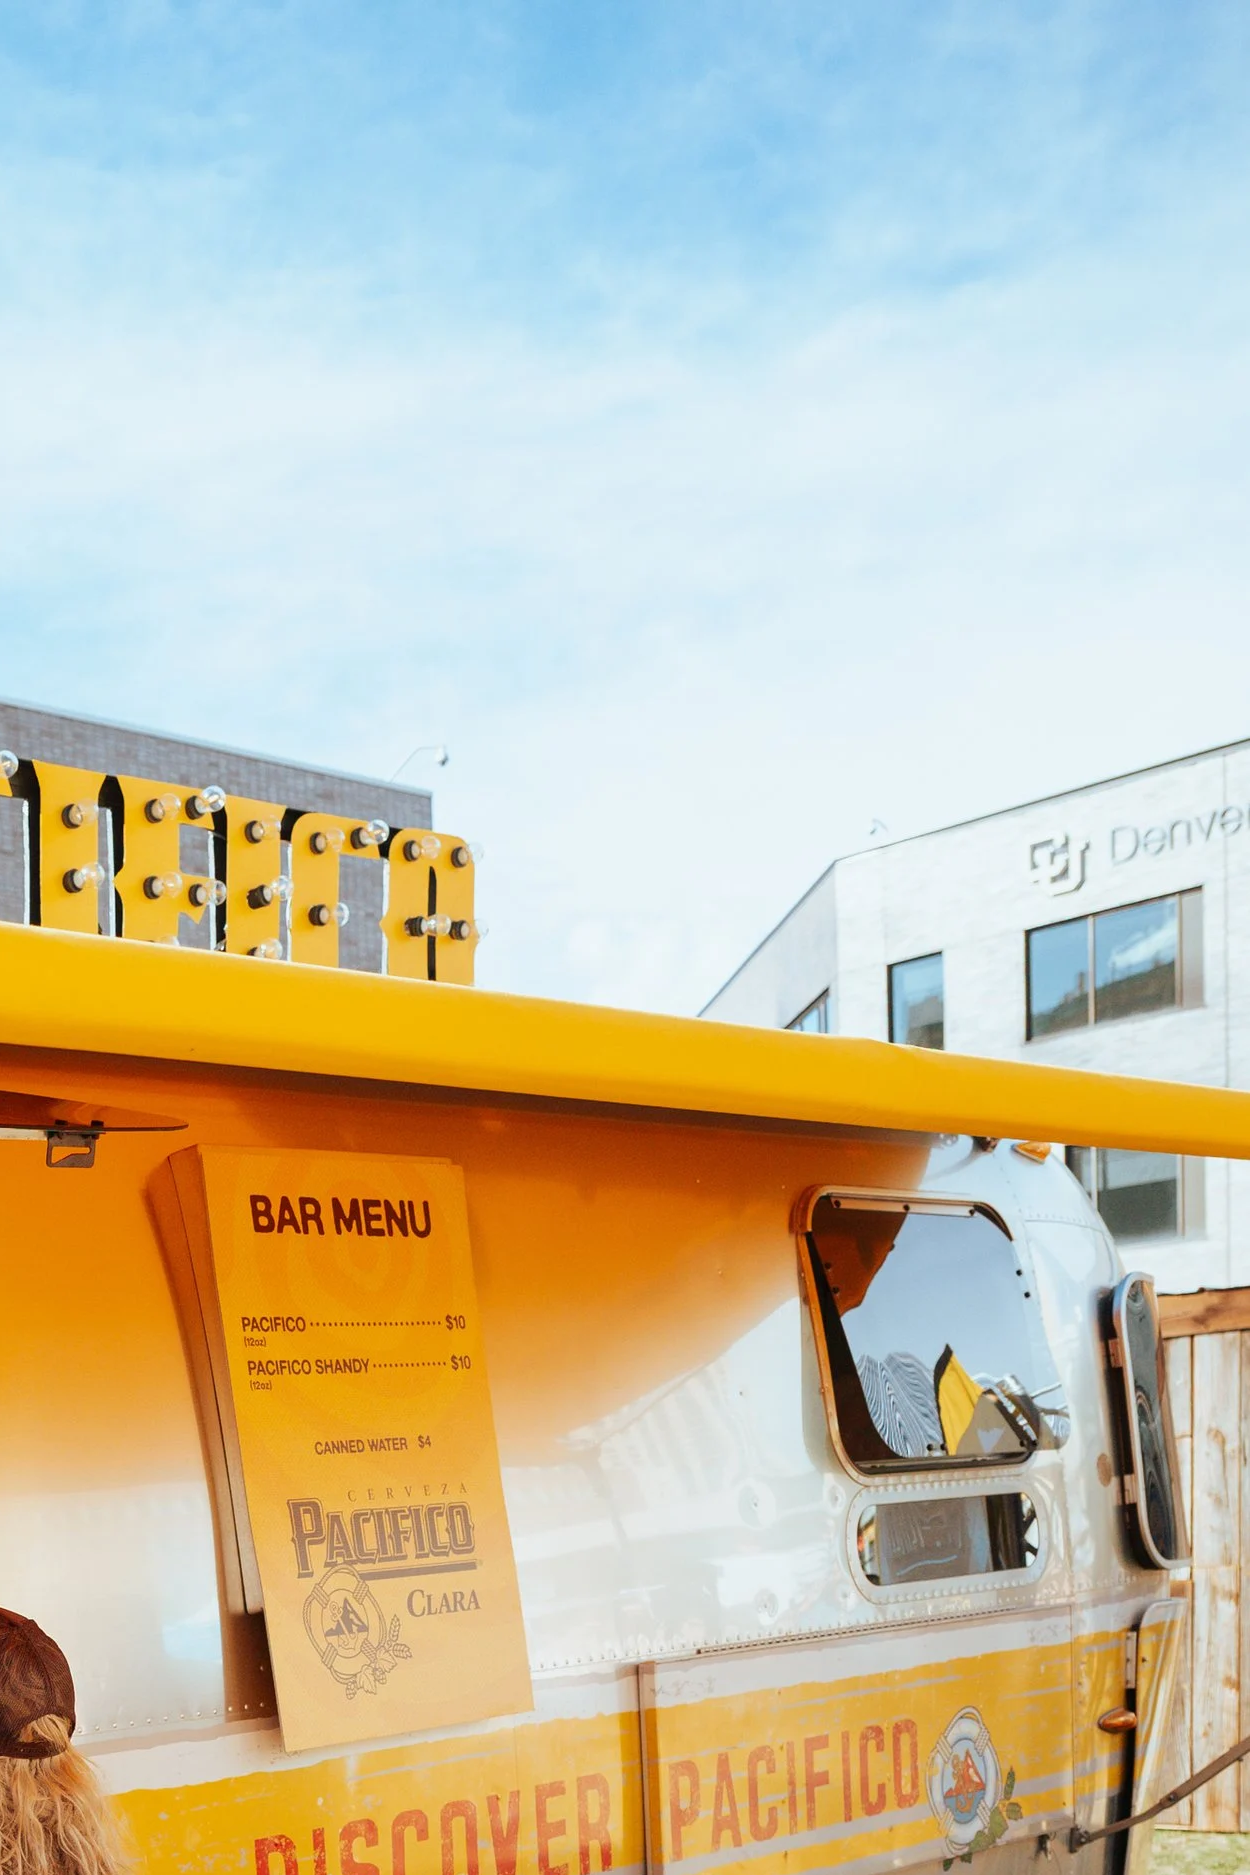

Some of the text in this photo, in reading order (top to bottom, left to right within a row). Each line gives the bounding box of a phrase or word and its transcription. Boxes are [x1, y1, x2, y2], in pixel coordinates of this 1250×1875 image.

[249, 1195, 432, 1239] BAR MENU
[241, 1314, 466, 1333] PACIFICO $10
[243, 1336, 267, 1348] (12oz)
[247, 1354, 472, 1376] PACIFICO SHANDY $10
[249, 1379, 273, 1391] (12oz)
[314, 1434, 432, 1456] CANNED WATER $4
[347, 1482, 468, 1502] CERVEZA
[287, 1497, 475, 1579] PACIFICO
[406, 1588, 482, 1618] CLARA
[667, 1718, 920, 1862] PACIFICO
